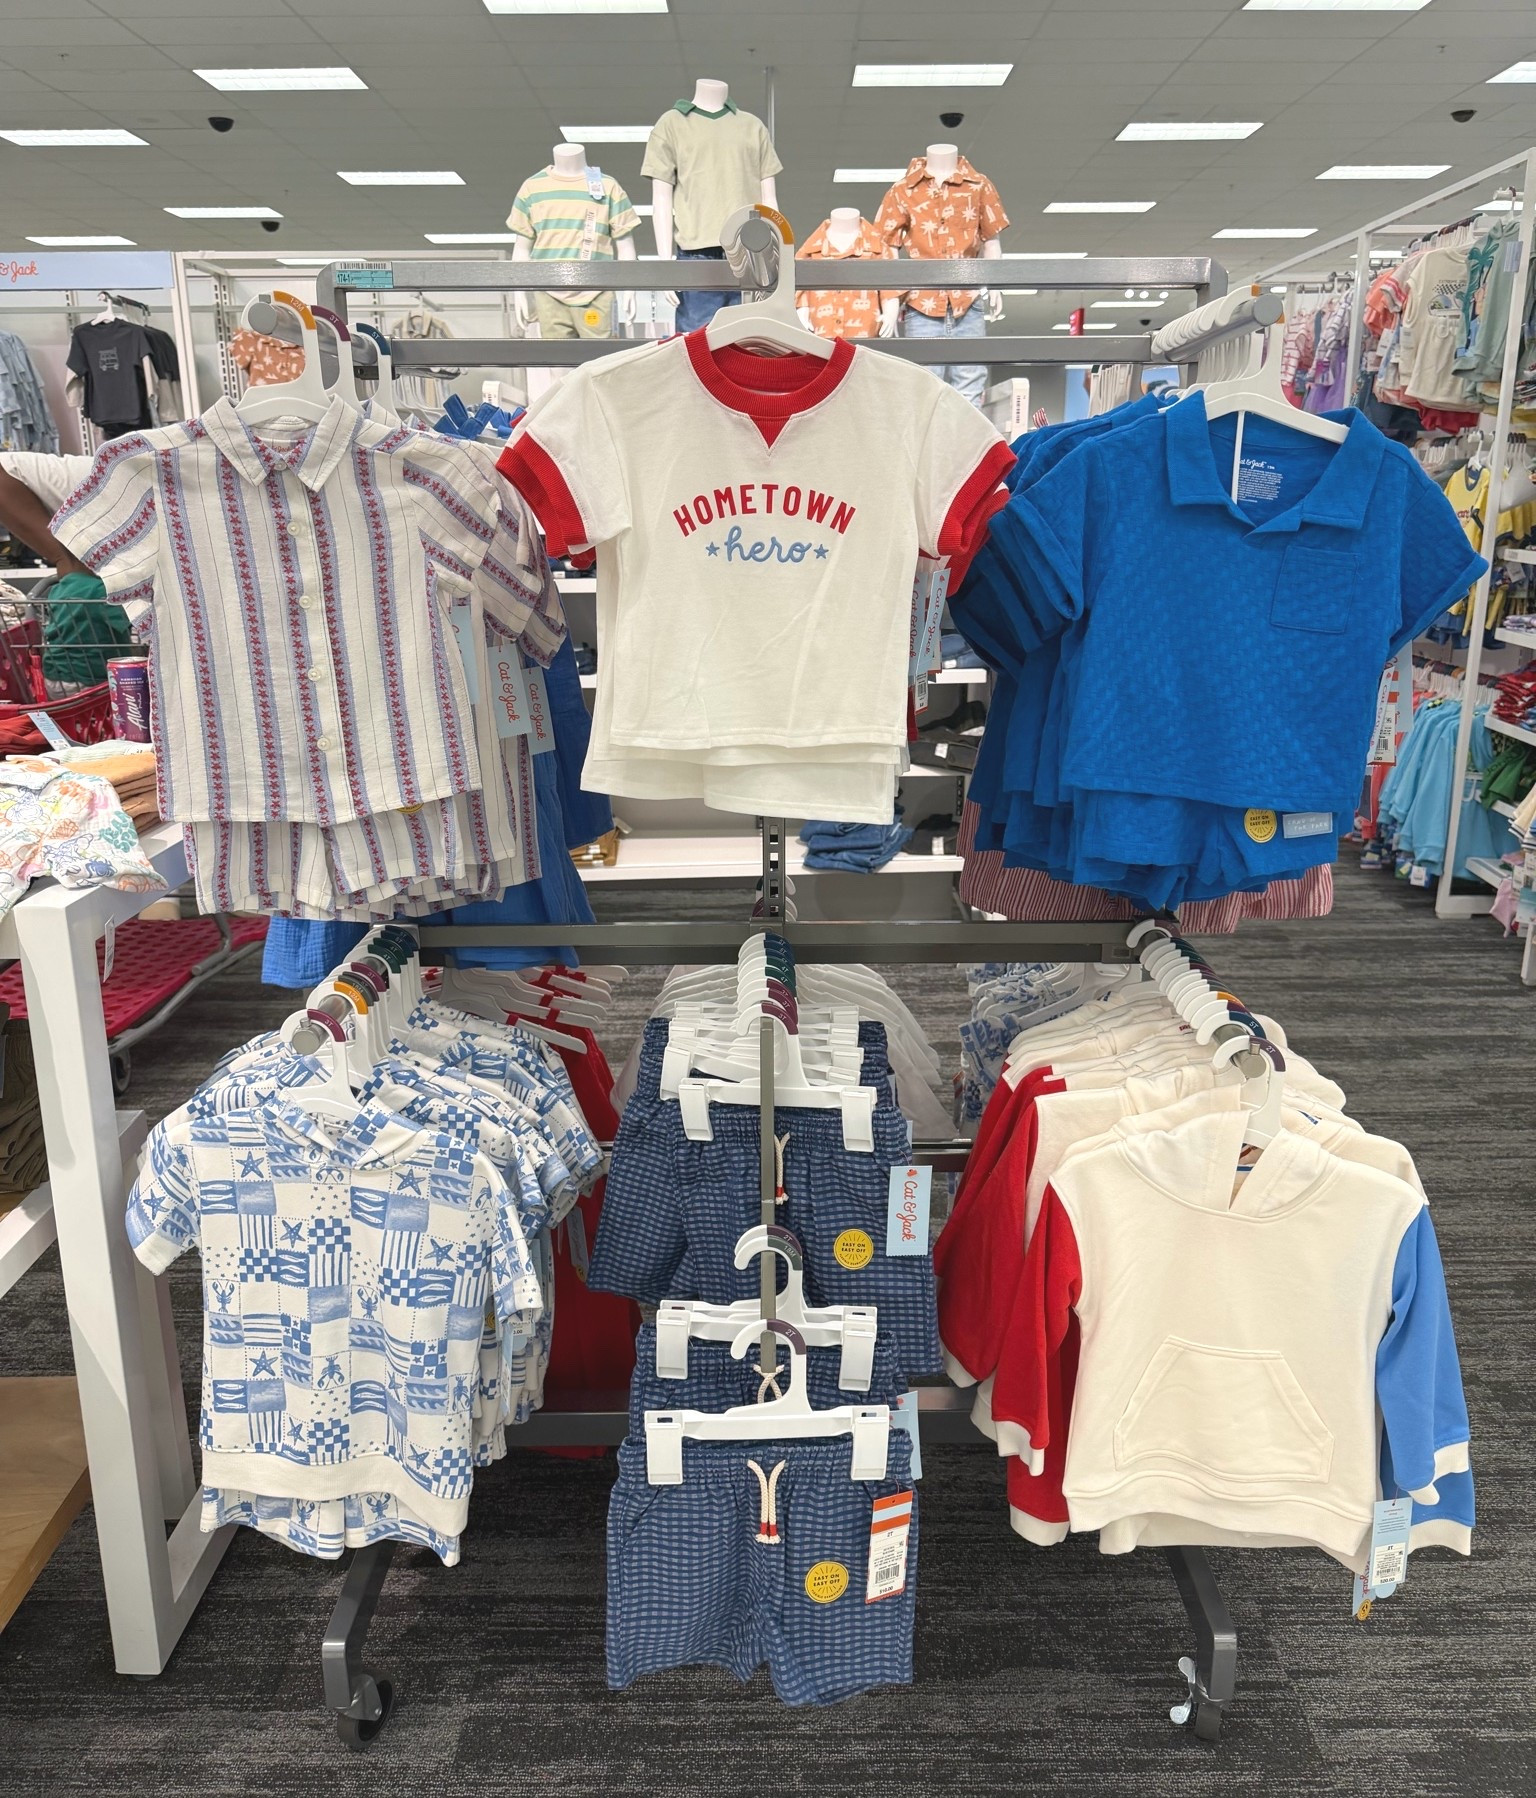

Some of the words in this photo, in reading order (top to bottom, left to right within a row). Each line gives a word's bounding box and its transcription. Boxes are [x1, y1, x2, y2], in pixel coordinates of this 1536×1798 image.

[11, 260, 39, 283] Jack
[290, 297, 304, 312] 12M
[329, 314, 339, 324] 3T
[371, 331, 381, 340] 5T
[673, 484, 856, 537] HOMETOWN
[724, 525, 813, 563] hero
[497, 661, 510, 685] Cat
[502, 682, 514, 695] &
[528, 683, 539, 702] Cat
[123, 692, 148, 731] Alani
[498, 695, 520, 724] Jack
[532, 702, 542, 713] &
[529, 713, 546, 741] Jack
[367, 971, 376, 979] 3T
[782, 1000, 791, 1008] 3T
[324, 1019, 334, 1027] 3T
[1250, 1020, 1259, 1029] 5T
[1266, 1045, 1276, 1054] 2T
[904, 1180, 918, 1200] Cat
[903, 1201, 917, 1213] &
[896, 1213, 917, 1242] Jack
[783, 1234, 793, 1242] 2T
[784, 1245, 796, 1258] 18M
[785, 1328, 796, 1338] 2T
